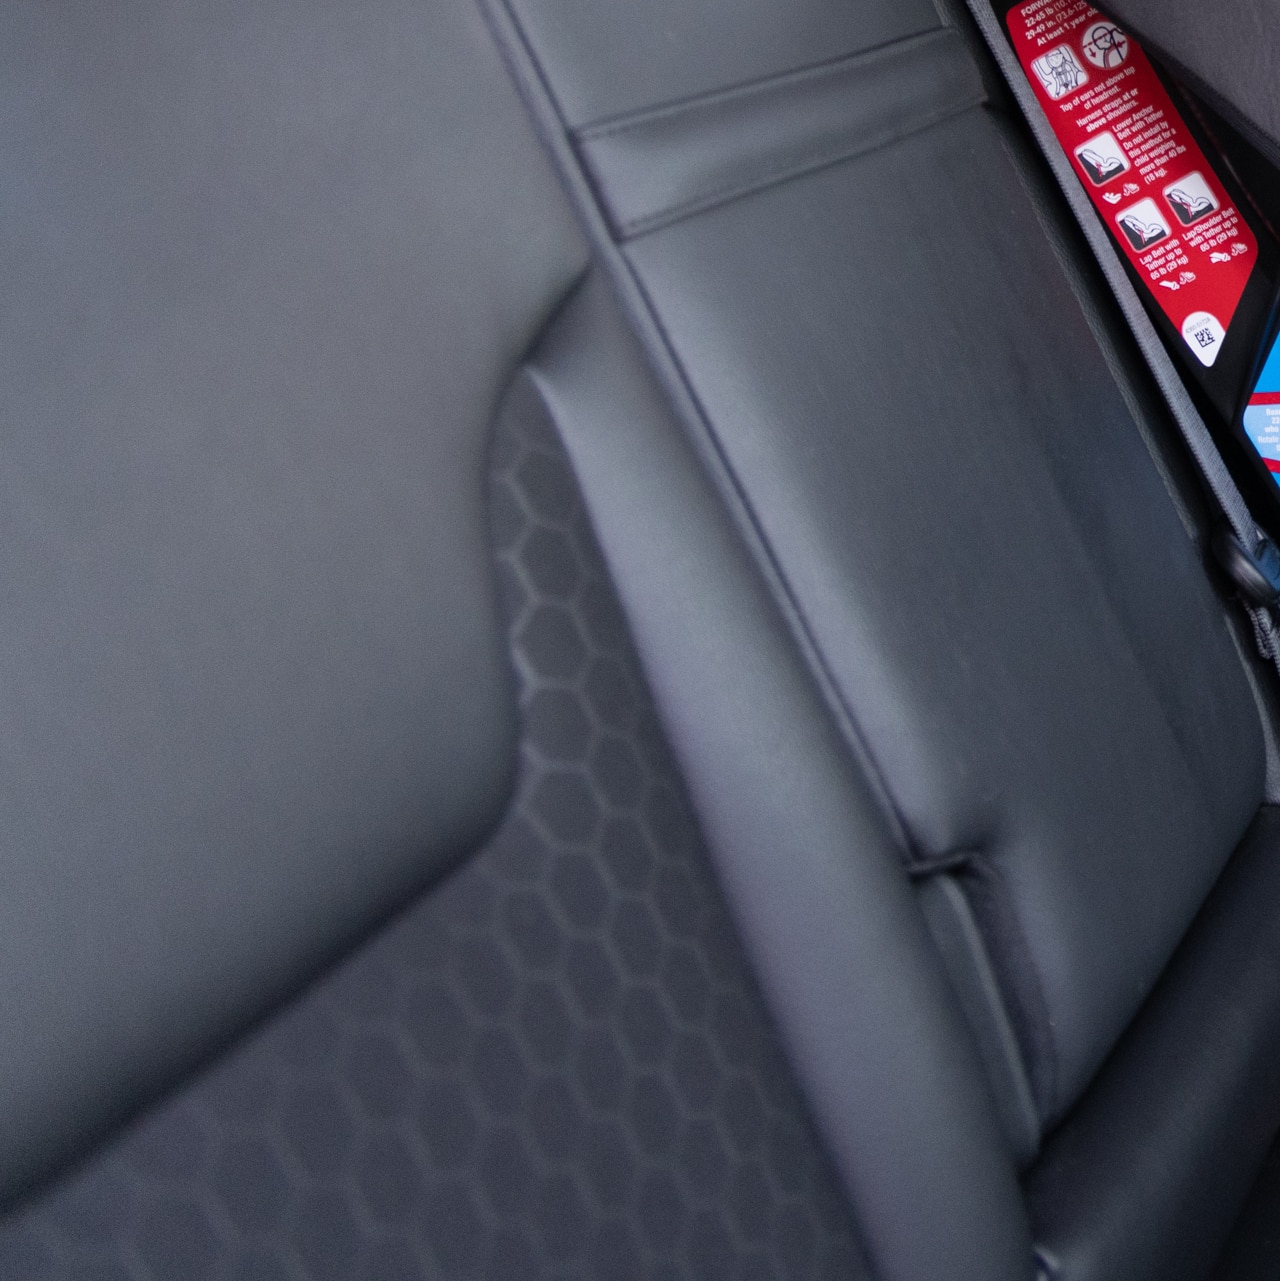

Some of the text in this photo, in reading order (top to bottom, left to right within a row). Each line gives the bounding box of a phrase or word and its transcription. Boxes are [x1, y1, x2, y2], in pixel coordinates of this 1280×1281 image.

[1024, 7, 1054, 27] 22-65 lb
[1025, 20, 1056, 40] 29-49 in.
[1037, 36, 1047, 46] At
[1045, 26, 1064, 40] least
[1070, 14, 1086, 29] year
[1059, 66, 1135, 112] Top of ears not above top
[1083, 85, 1121, 110] of headrest.
[1076, 88, 1138, 127] Harness straps at or
[1085, 99, 1138, 132] above shoulders.
[1111, 104, 1154, 132] Lower Anchor
[1116, 109, 1163, 140] Belt with Tether
[1122, 121, 1168, 150] Do not install by
[1181, 207, 1235, 241] Lap/Shoulder Belt
[1189, 216, 1238, 247] with Tether up to
[1139, 239, 1180, 265] Lap Belt with
[1199, 226, 1238, 252] 65 lb (29 kg)
[1145, 247, 1182, 271] Tether up to
